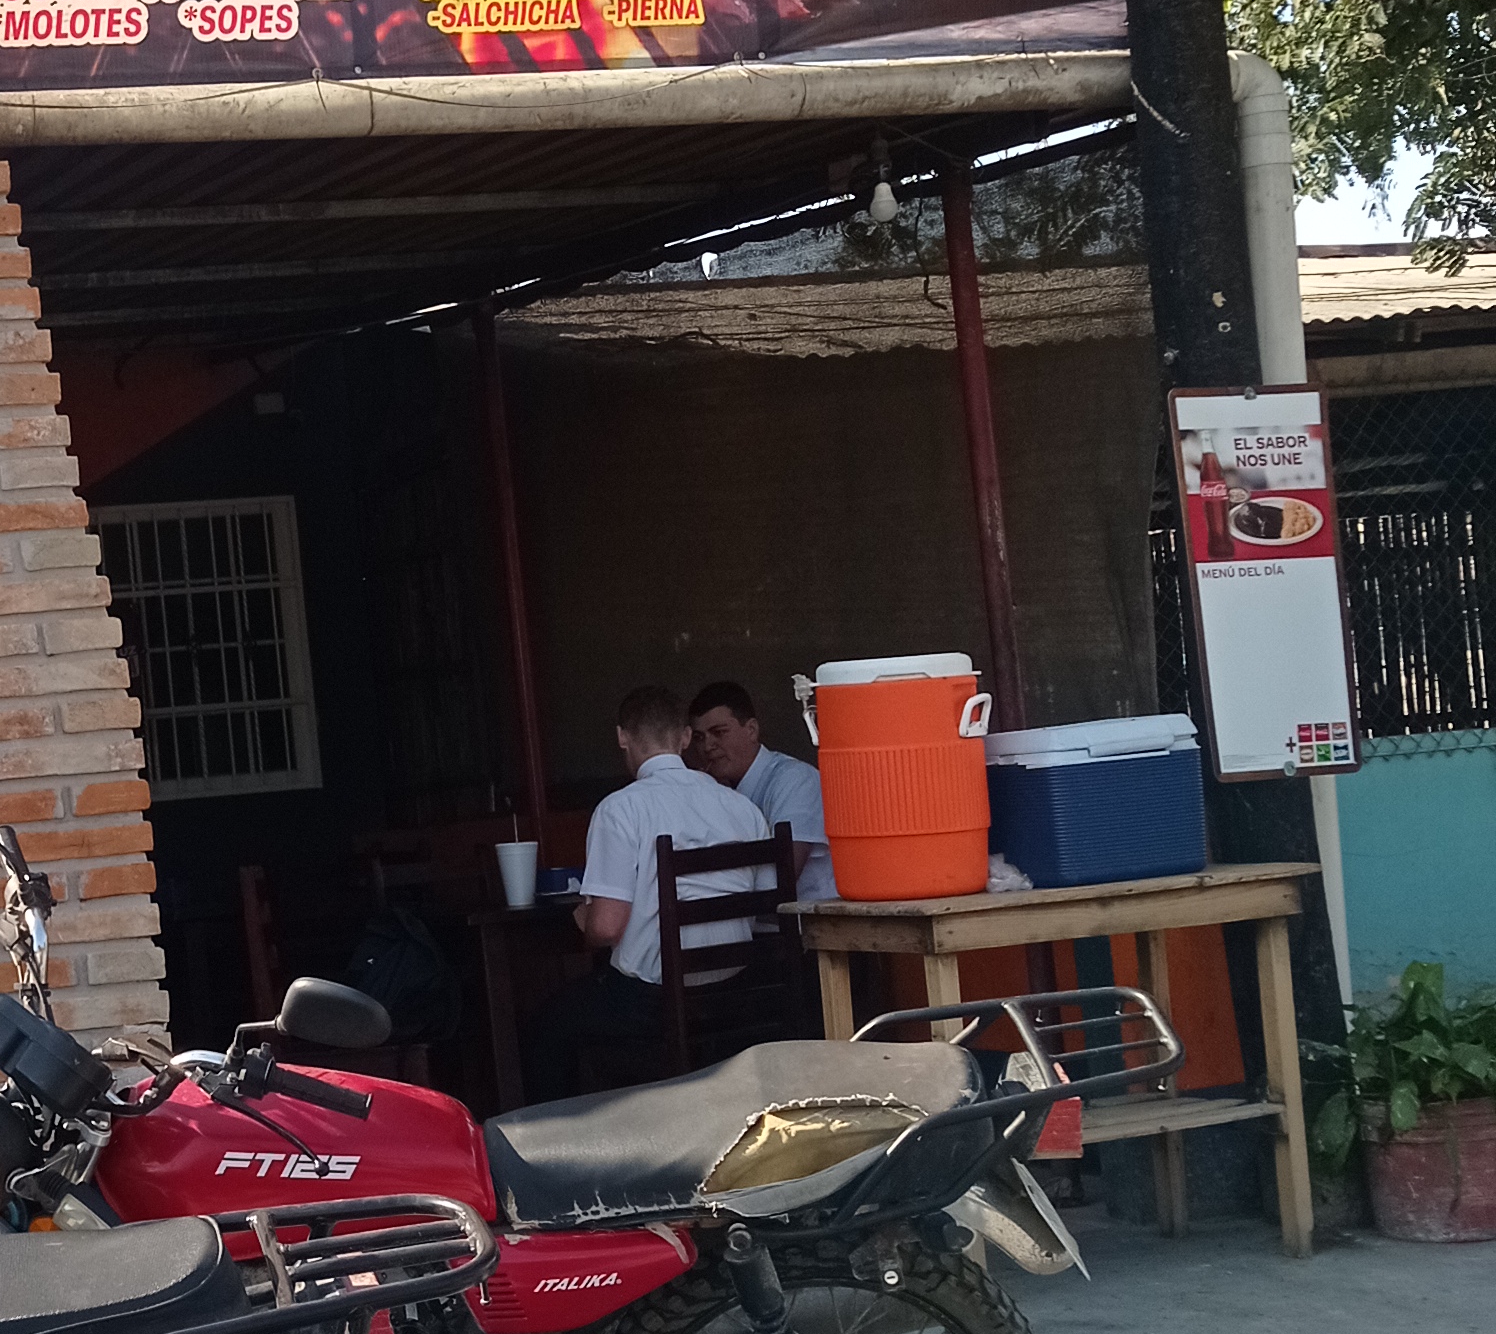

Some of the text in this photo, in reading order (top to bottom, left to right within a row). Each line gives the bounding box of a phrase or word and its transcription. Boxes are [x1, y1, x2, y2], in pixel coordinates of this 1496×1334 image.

[1233, 435, 1308, 451] EL SABOR
[1235, 452, 1302, 467] NOS UNE
[1201, 563, 1285, 579] MENÚ DEL DÍA
[215, 1152, 361, 1180] FT125
[533, 1272, 618, 1293] ITALIKA
